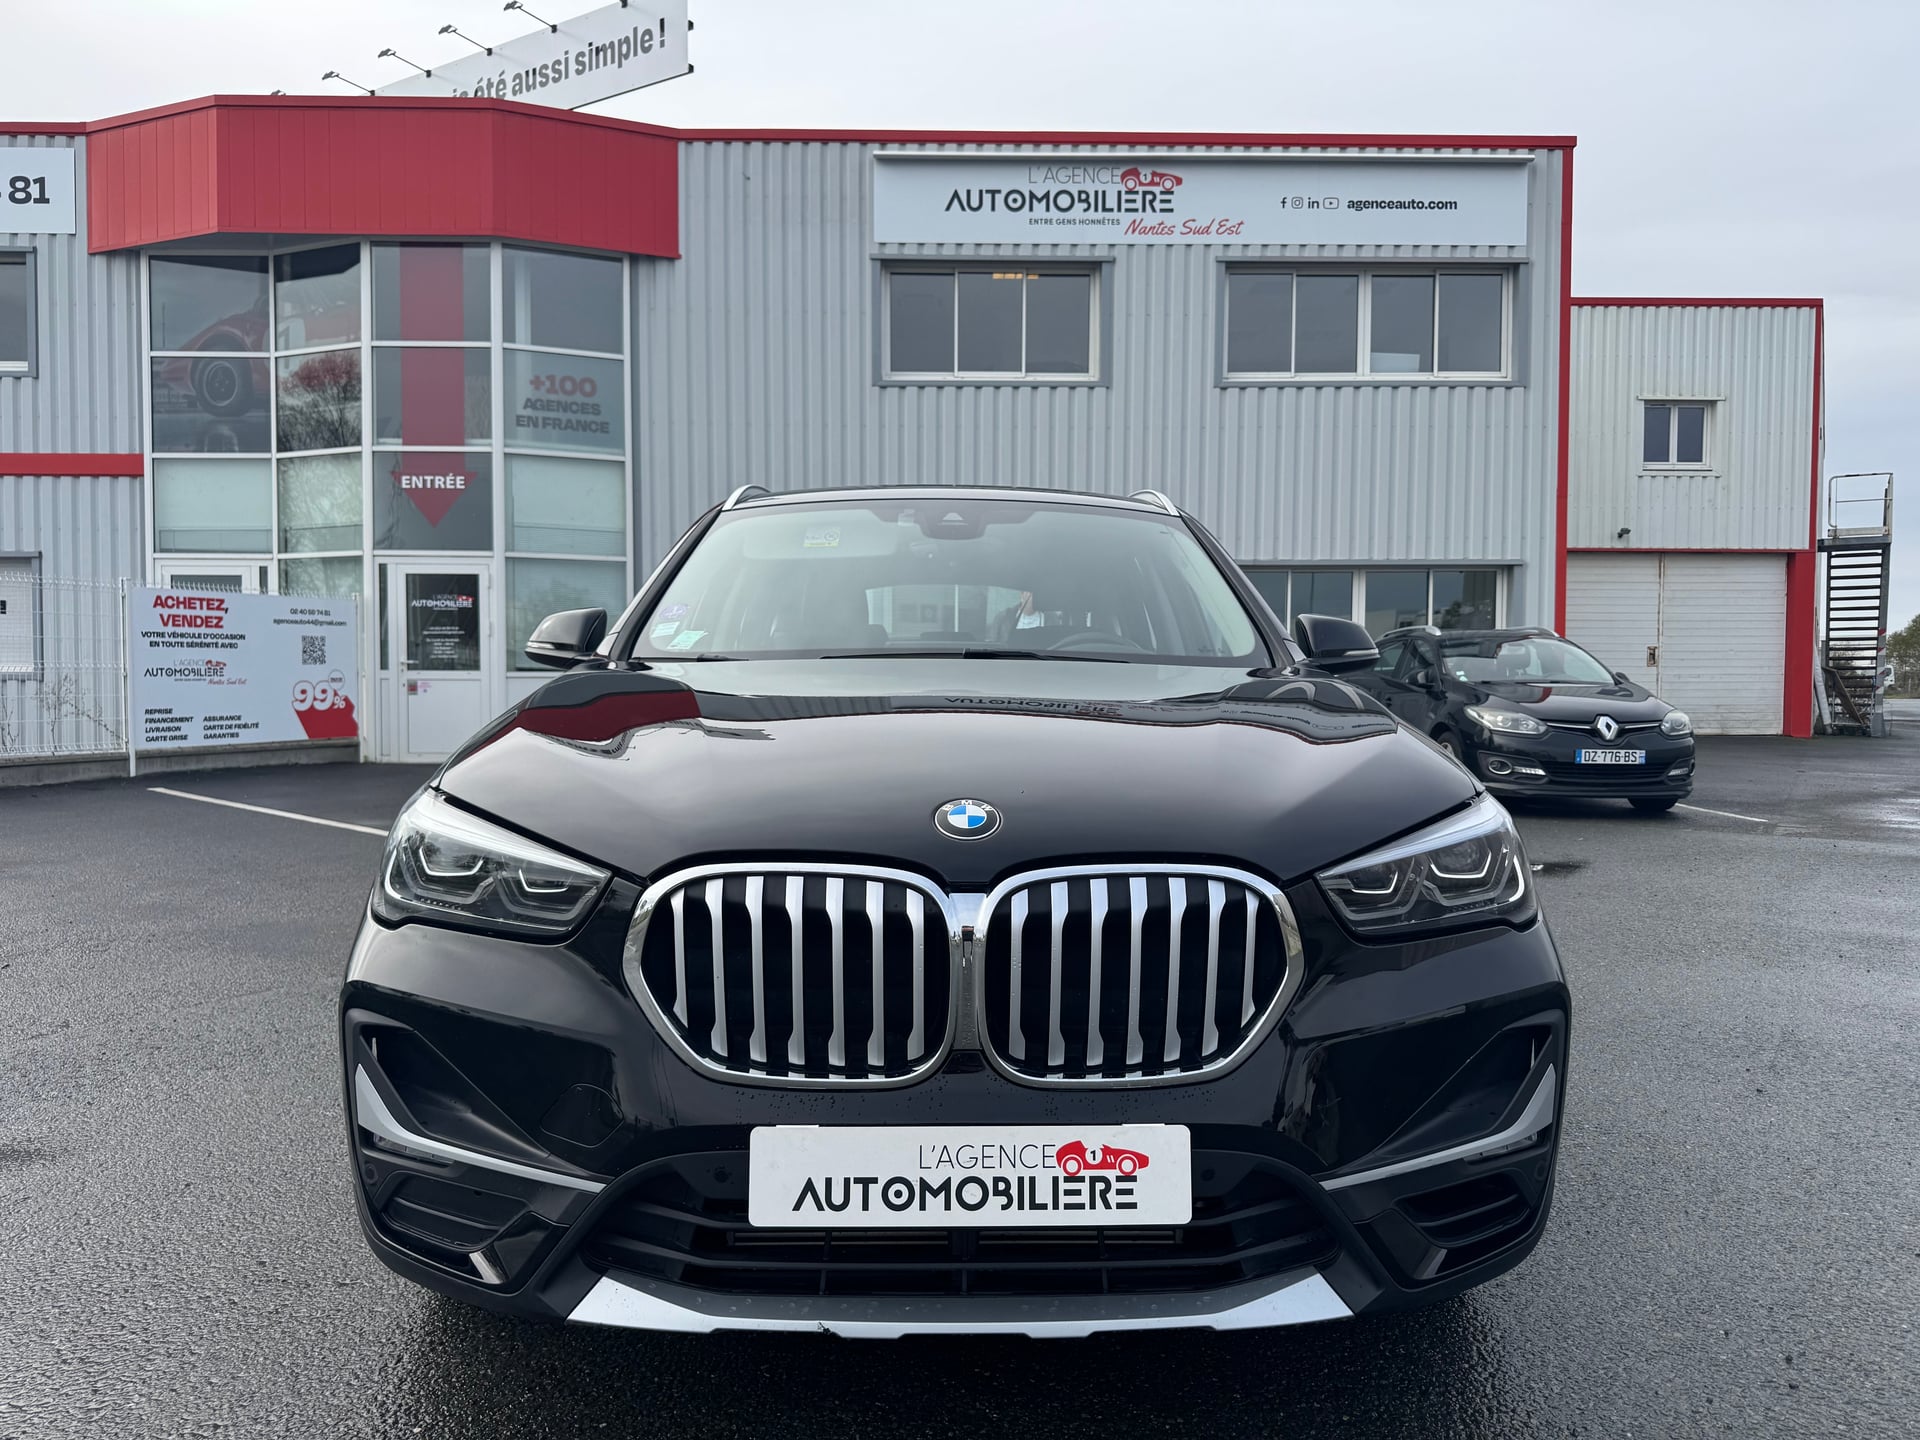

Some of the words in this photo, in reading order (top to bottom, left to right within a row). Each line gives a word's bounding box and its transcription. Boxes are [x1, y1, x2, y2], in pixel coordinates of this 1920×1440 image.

[474, 69, 507, 100] été
[512, 50, 569, 97] aussi
[1028, 166, 1121, 184] L'AGENCE
[8, 176, 50, 204] 81
[1347, 199, 1458, 212] agenceauto.com
[1029, 218, 1054, 226] ENTRE
[1055, 218, 1077, 226] GENS
[1078, 217, 1121, 226] HONNÊTES
[1124, 218, 1176, 236] Nantes
[1180, 219, 1212, 235] Sud
[1216, 219, 1245, 236] Est
[529, 374, 597, 398] +100
[523, 398, 601, 416] AGENCES
[515, 415, 540, 429] EN
[542, 418, 610, 434] FRANCE
[401, 473, 466, 489] ENTRÉE
[153, 595, 229, 614] ACHETEZ,
[159, 613, 224, 629] VENDEZ
[141, 631, 166, 639] VOTRE
[167, 631, 202, 640] VÉHICULE
[185, 641, 219, 649] SÉRÉNITÉ
[145, 716, 194, 724] FINANCEMENT
[234, 722, 259, 730] FIDÉLITÉ
[204, 732, 239, 740] GARANTIES
[1584, 751, 1637, 762] DZ-776-BS
[919, 1144, 1056, 1170] L'AGENCE
